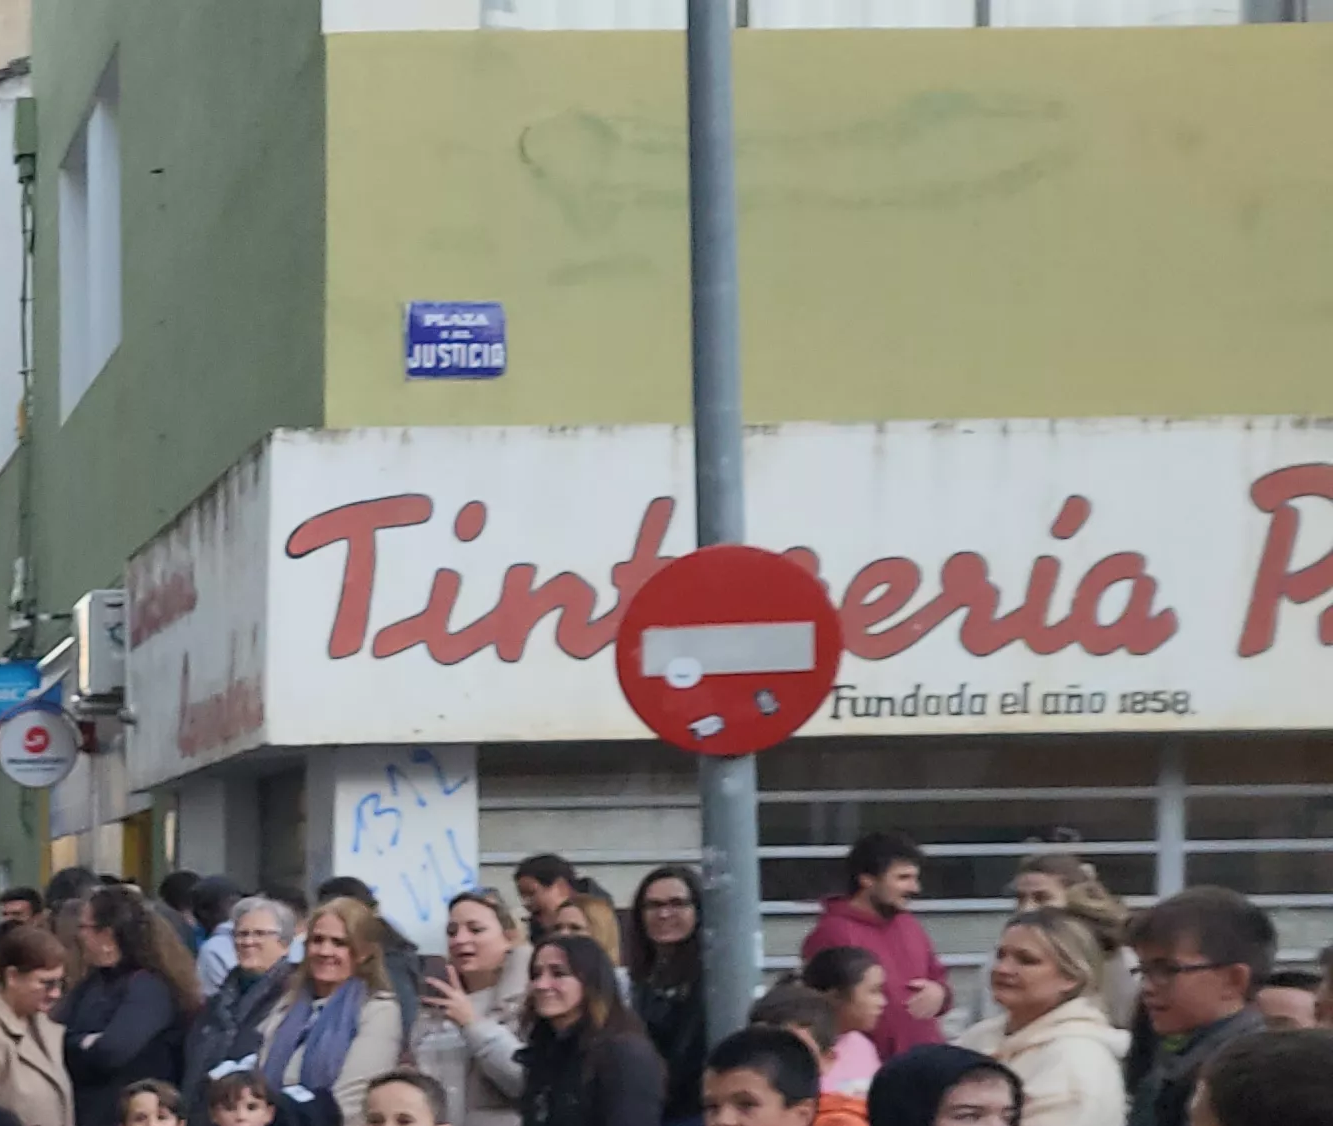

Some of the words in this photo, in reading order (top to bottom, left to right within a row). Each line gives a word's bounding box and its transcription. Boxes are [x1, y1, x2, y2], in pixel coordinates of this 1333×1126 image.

[423, 312, 490, 327] PLAZA
[407, 342, 505, 369] JUSTICIA
[285, 493, 1179, 666] Tintería
[829, 682, 988, 719] Fundada
[1000, 681, 1031, 715] el
[1041, 684, 1106, 715] año
